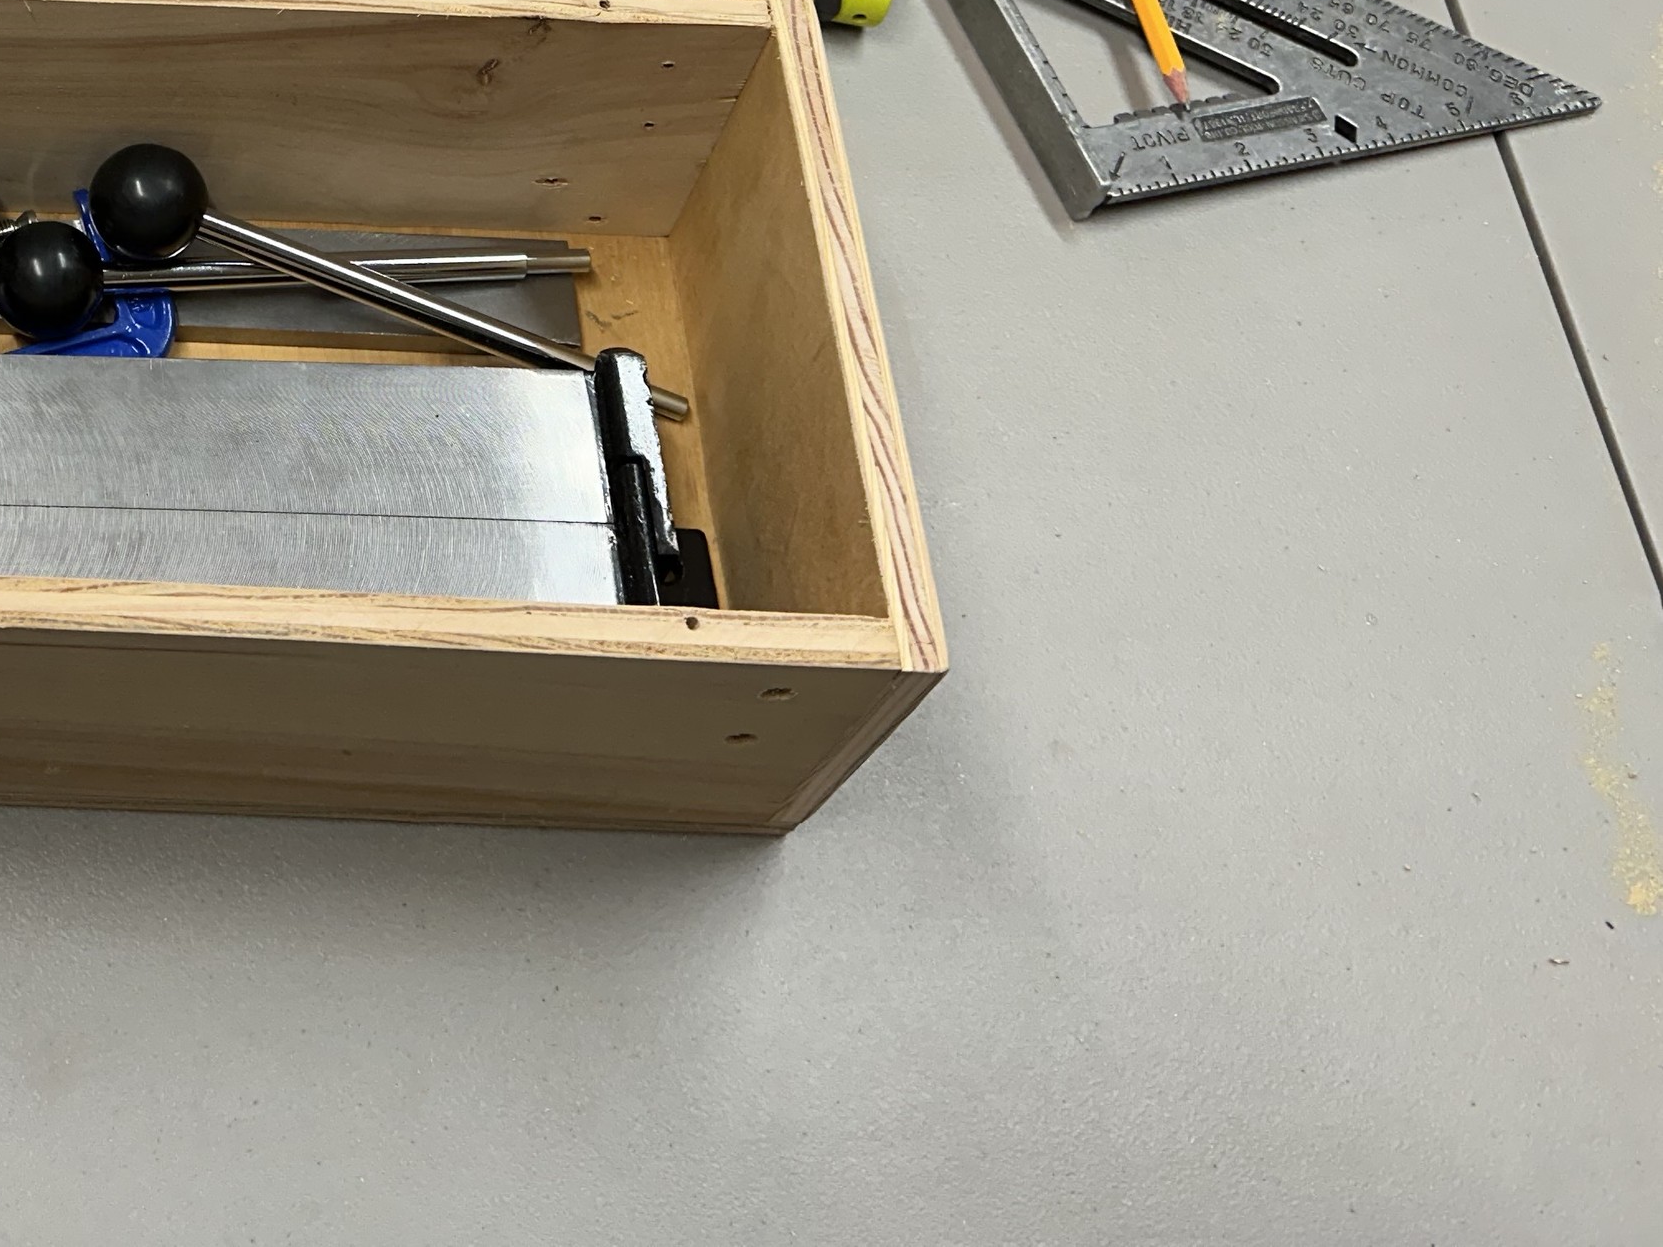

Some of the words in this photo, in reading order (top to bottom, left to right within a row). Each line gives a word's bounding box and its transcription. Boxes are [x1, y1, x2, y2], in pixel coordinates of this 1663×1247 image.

[1333, 18, 1359, 39] 30
[1365, 12, 1391, 33] 70
[1309, 57, 1367, 92] CUTS
[1380, 50, 1469, 99] COMMON
[1485, 65, 1535, 98] DEG.
[1380, 92, 1426, 120] TOP
[1132, 127, 1191, 151] PIVOT
[1234, 141, 1251, 156] 2
[1302, 127, 1319, 144] 3
[1374, 115, 1389, 131] 4
